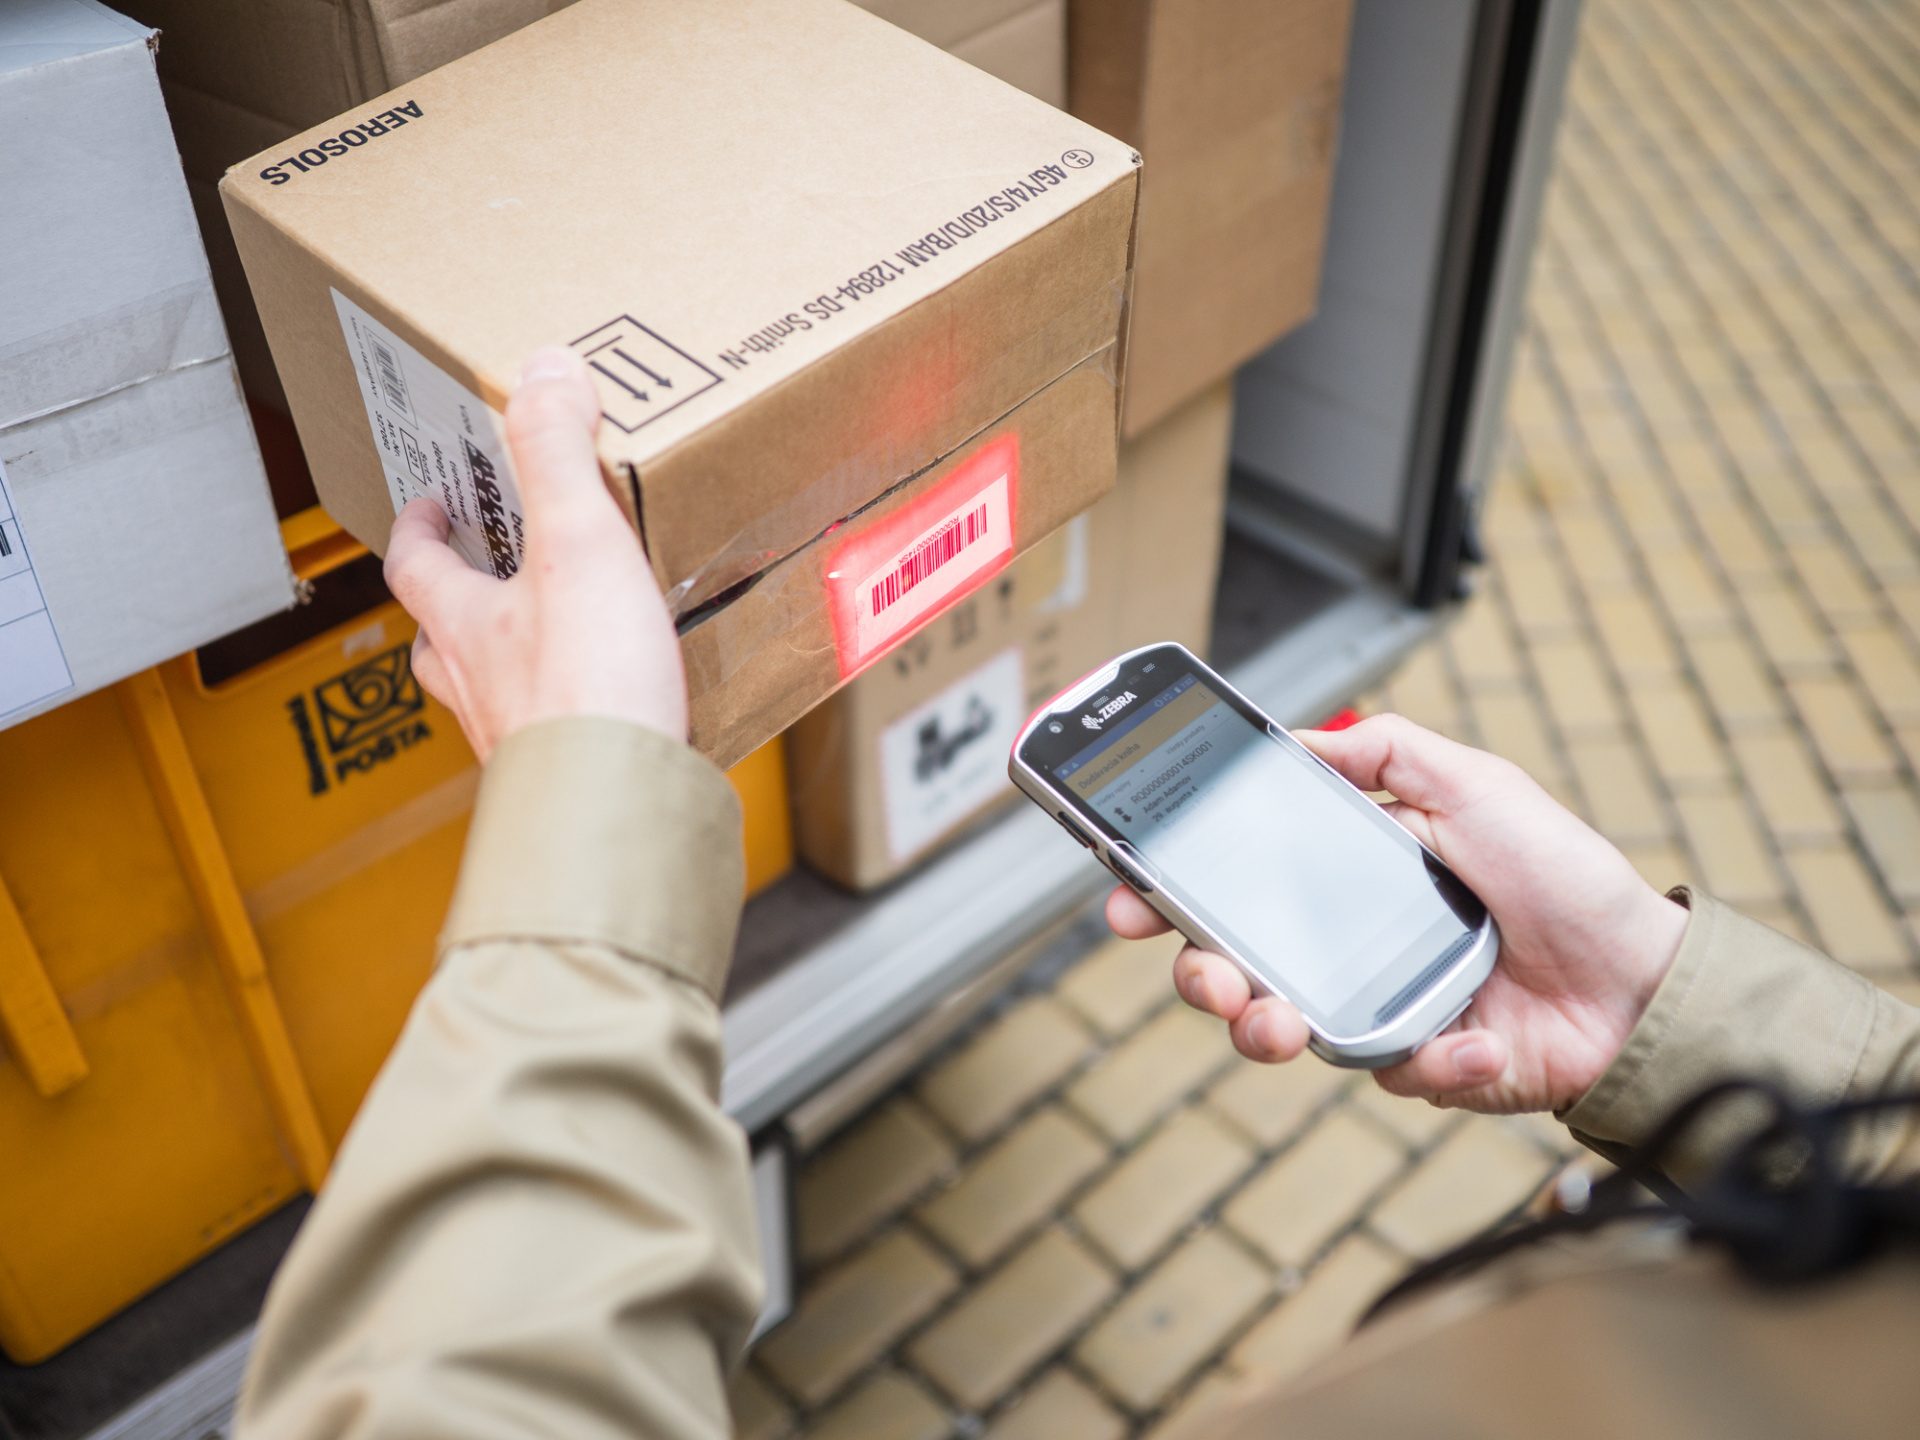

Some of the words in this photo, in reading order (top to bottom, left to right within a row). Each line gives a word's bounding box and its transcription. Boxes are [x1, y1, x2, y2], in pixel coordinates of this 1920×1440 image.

[260, 100, 424, 186] AEROSOLS
[895, 163, 1067, 267] 4G/Y4/S/20/D/BAM
[804, 256, 903, 320] 12894-DS
[718, 313, 811, 370] Smith-N
[406, 442, 419, 470] 221
[430, 439, 447, 480] deep
[441, 480, 459, 523] black
[449, 459, 471, 528] tiefschwarz
[477, 448, 519, 580] MOLOTO
[1098, 691, 1138, 720] ZEBRA
